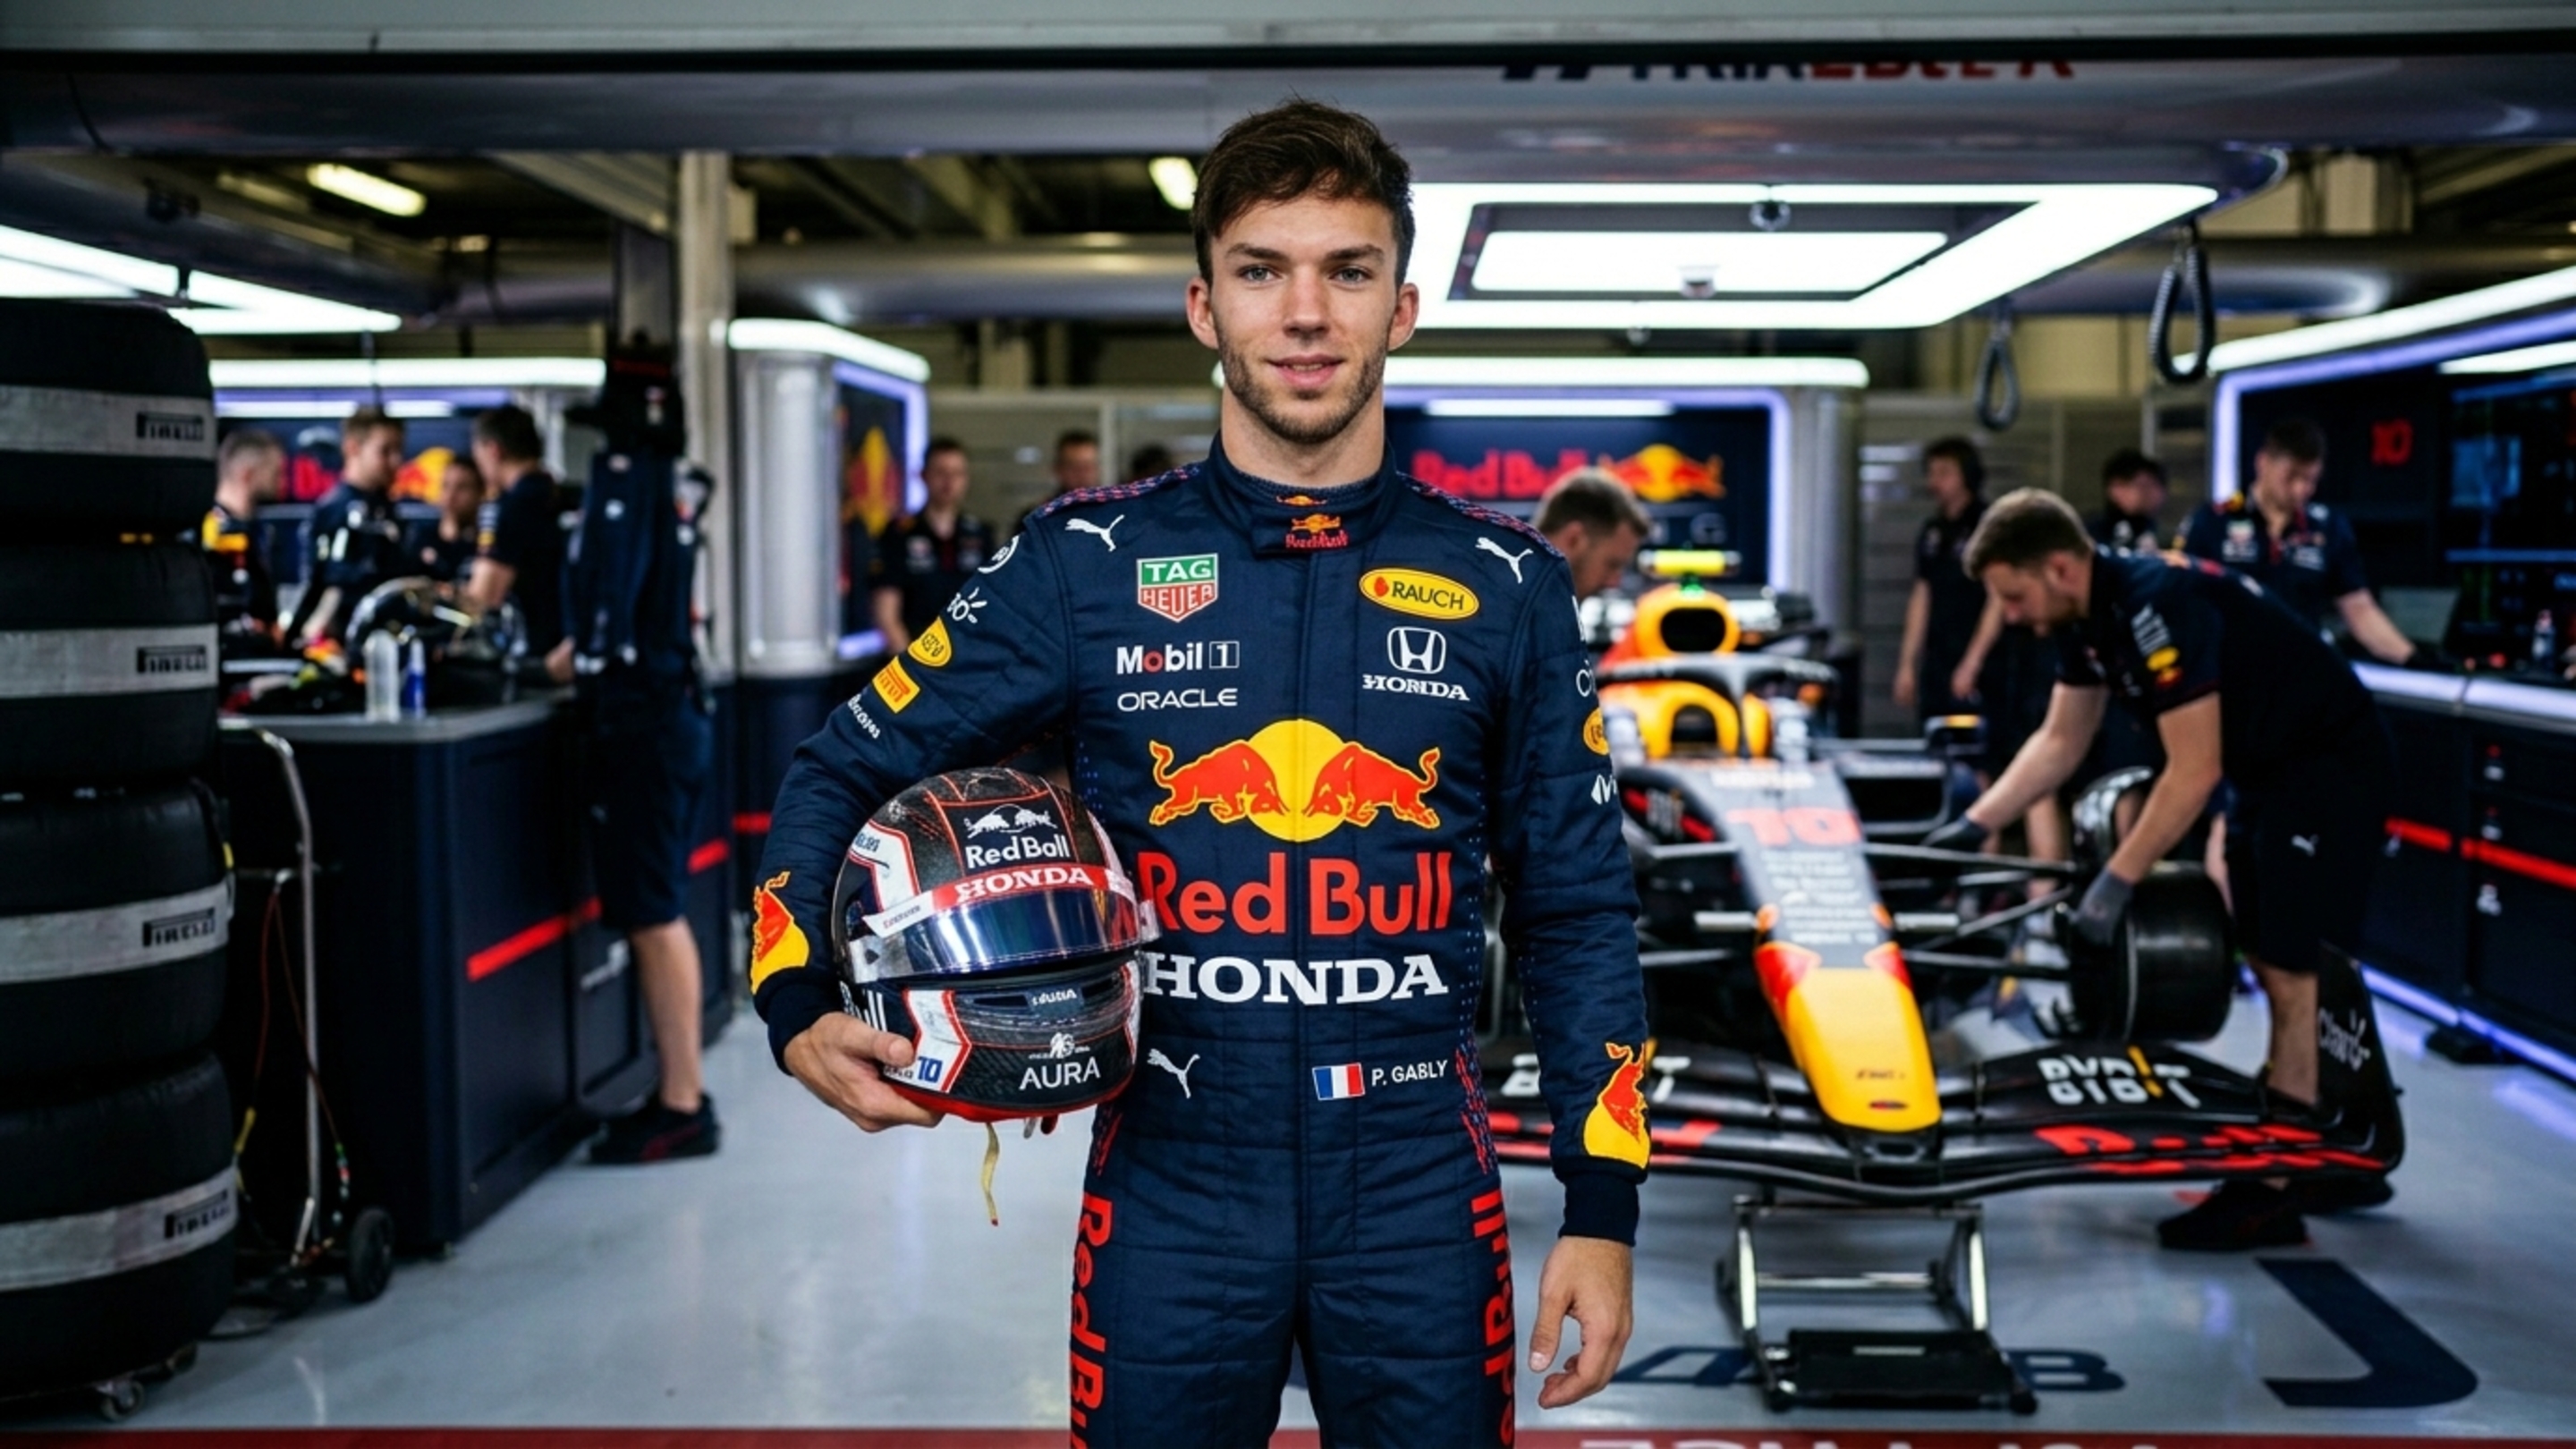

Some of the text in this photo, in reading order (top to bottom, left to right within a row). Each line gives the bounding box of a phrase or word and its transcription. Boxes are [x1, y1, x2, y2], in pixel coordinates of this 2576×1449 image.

[1145, 560, 1212, 581] TAG
[1143, 584, 1213, 615] HEUER
[1392, 580, 1465, 610] RAUCH
[1116, 641, 1203, 674] Mobil
[1117, 688, 1238, 712] ORACLE
[1726, 807, 1862, 846] 10
[965, 835, 1021, 869] Red
[954, 867, 1094, 903] HONDA
[1137, 852, 1452, 936] Red Bull
[1143, 952, 1449, 1005] HONDA
[918, 1056, 943, 1083] 10
[1019, 1055, 1101, 1089] AURA
[1372, 1060, 1448, 1087] P. GABLY
